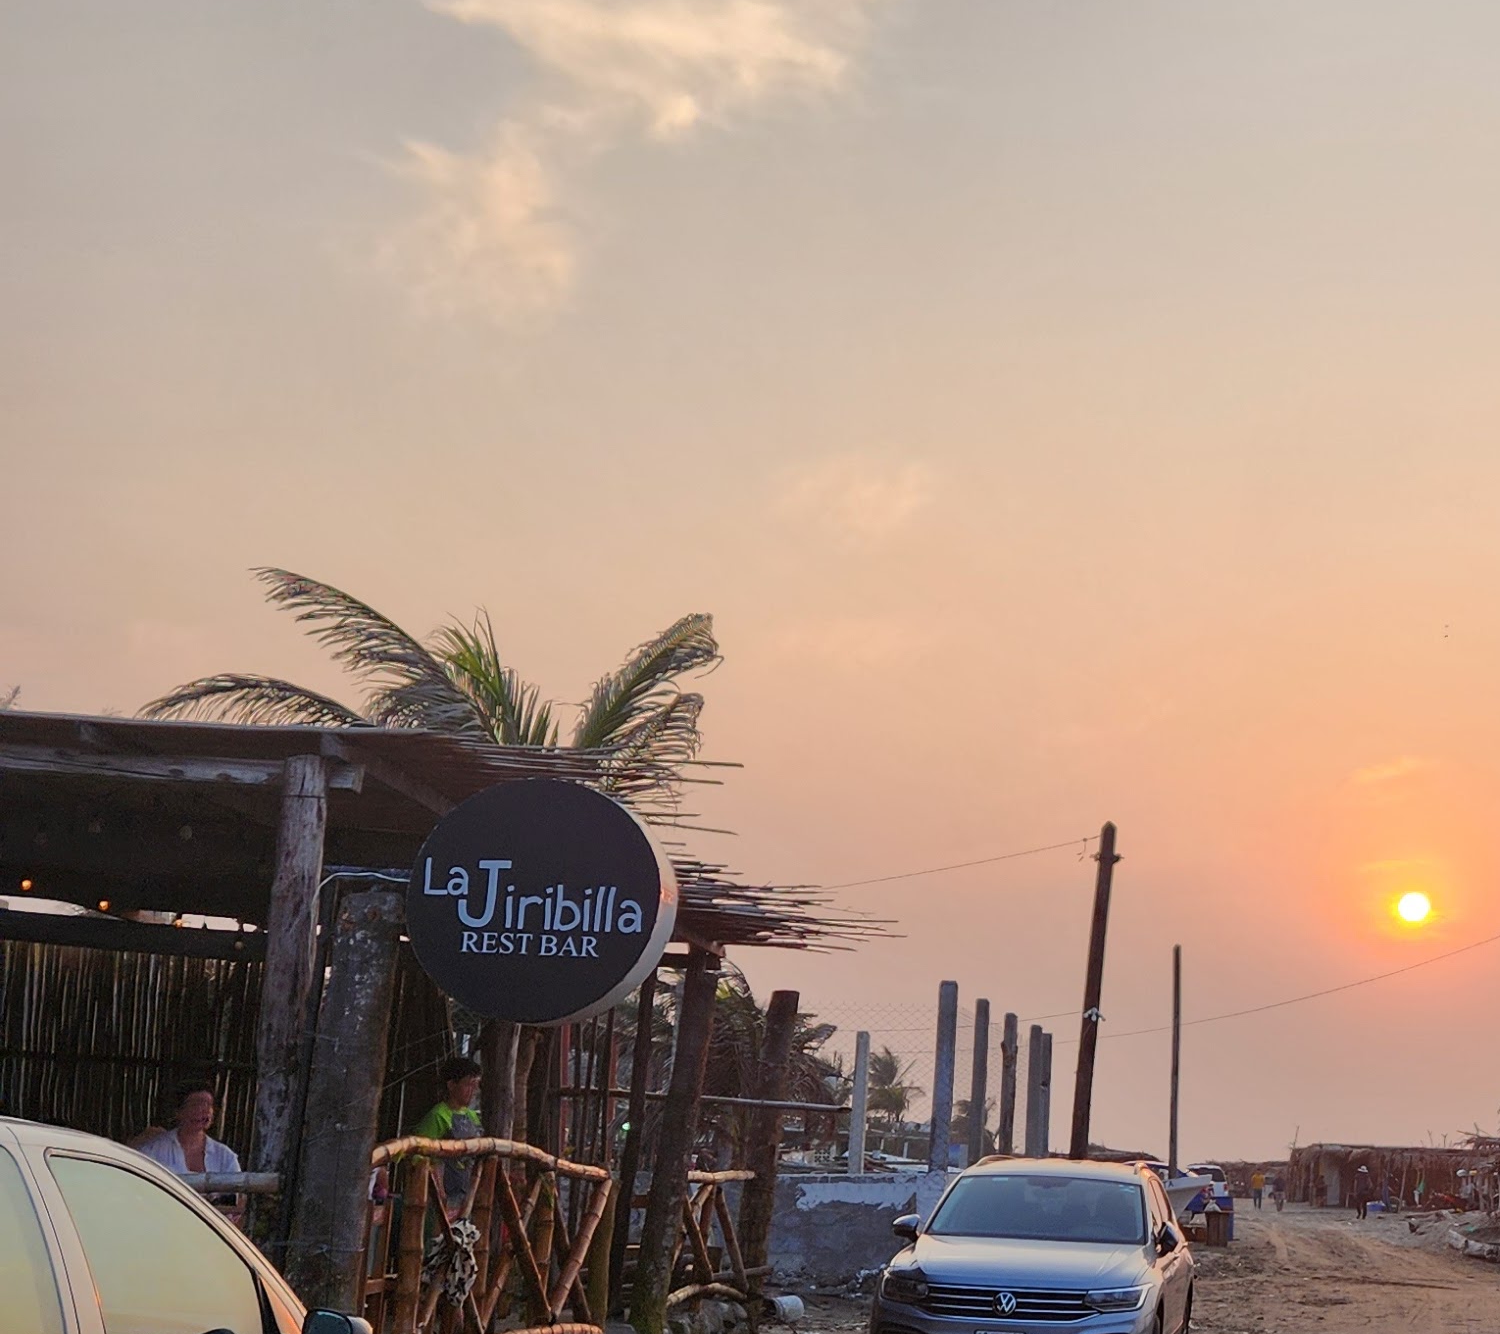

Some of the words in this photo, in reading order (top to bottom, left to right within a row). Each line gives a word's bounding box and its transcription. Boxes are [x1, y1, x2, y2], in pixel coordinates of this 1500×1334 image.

[424, 857, 469, 896] La
[458, 860, 642, 934] Jiribilla
[460, 931, 534, 955] REST
[538, 934, 599, 958] BAR
